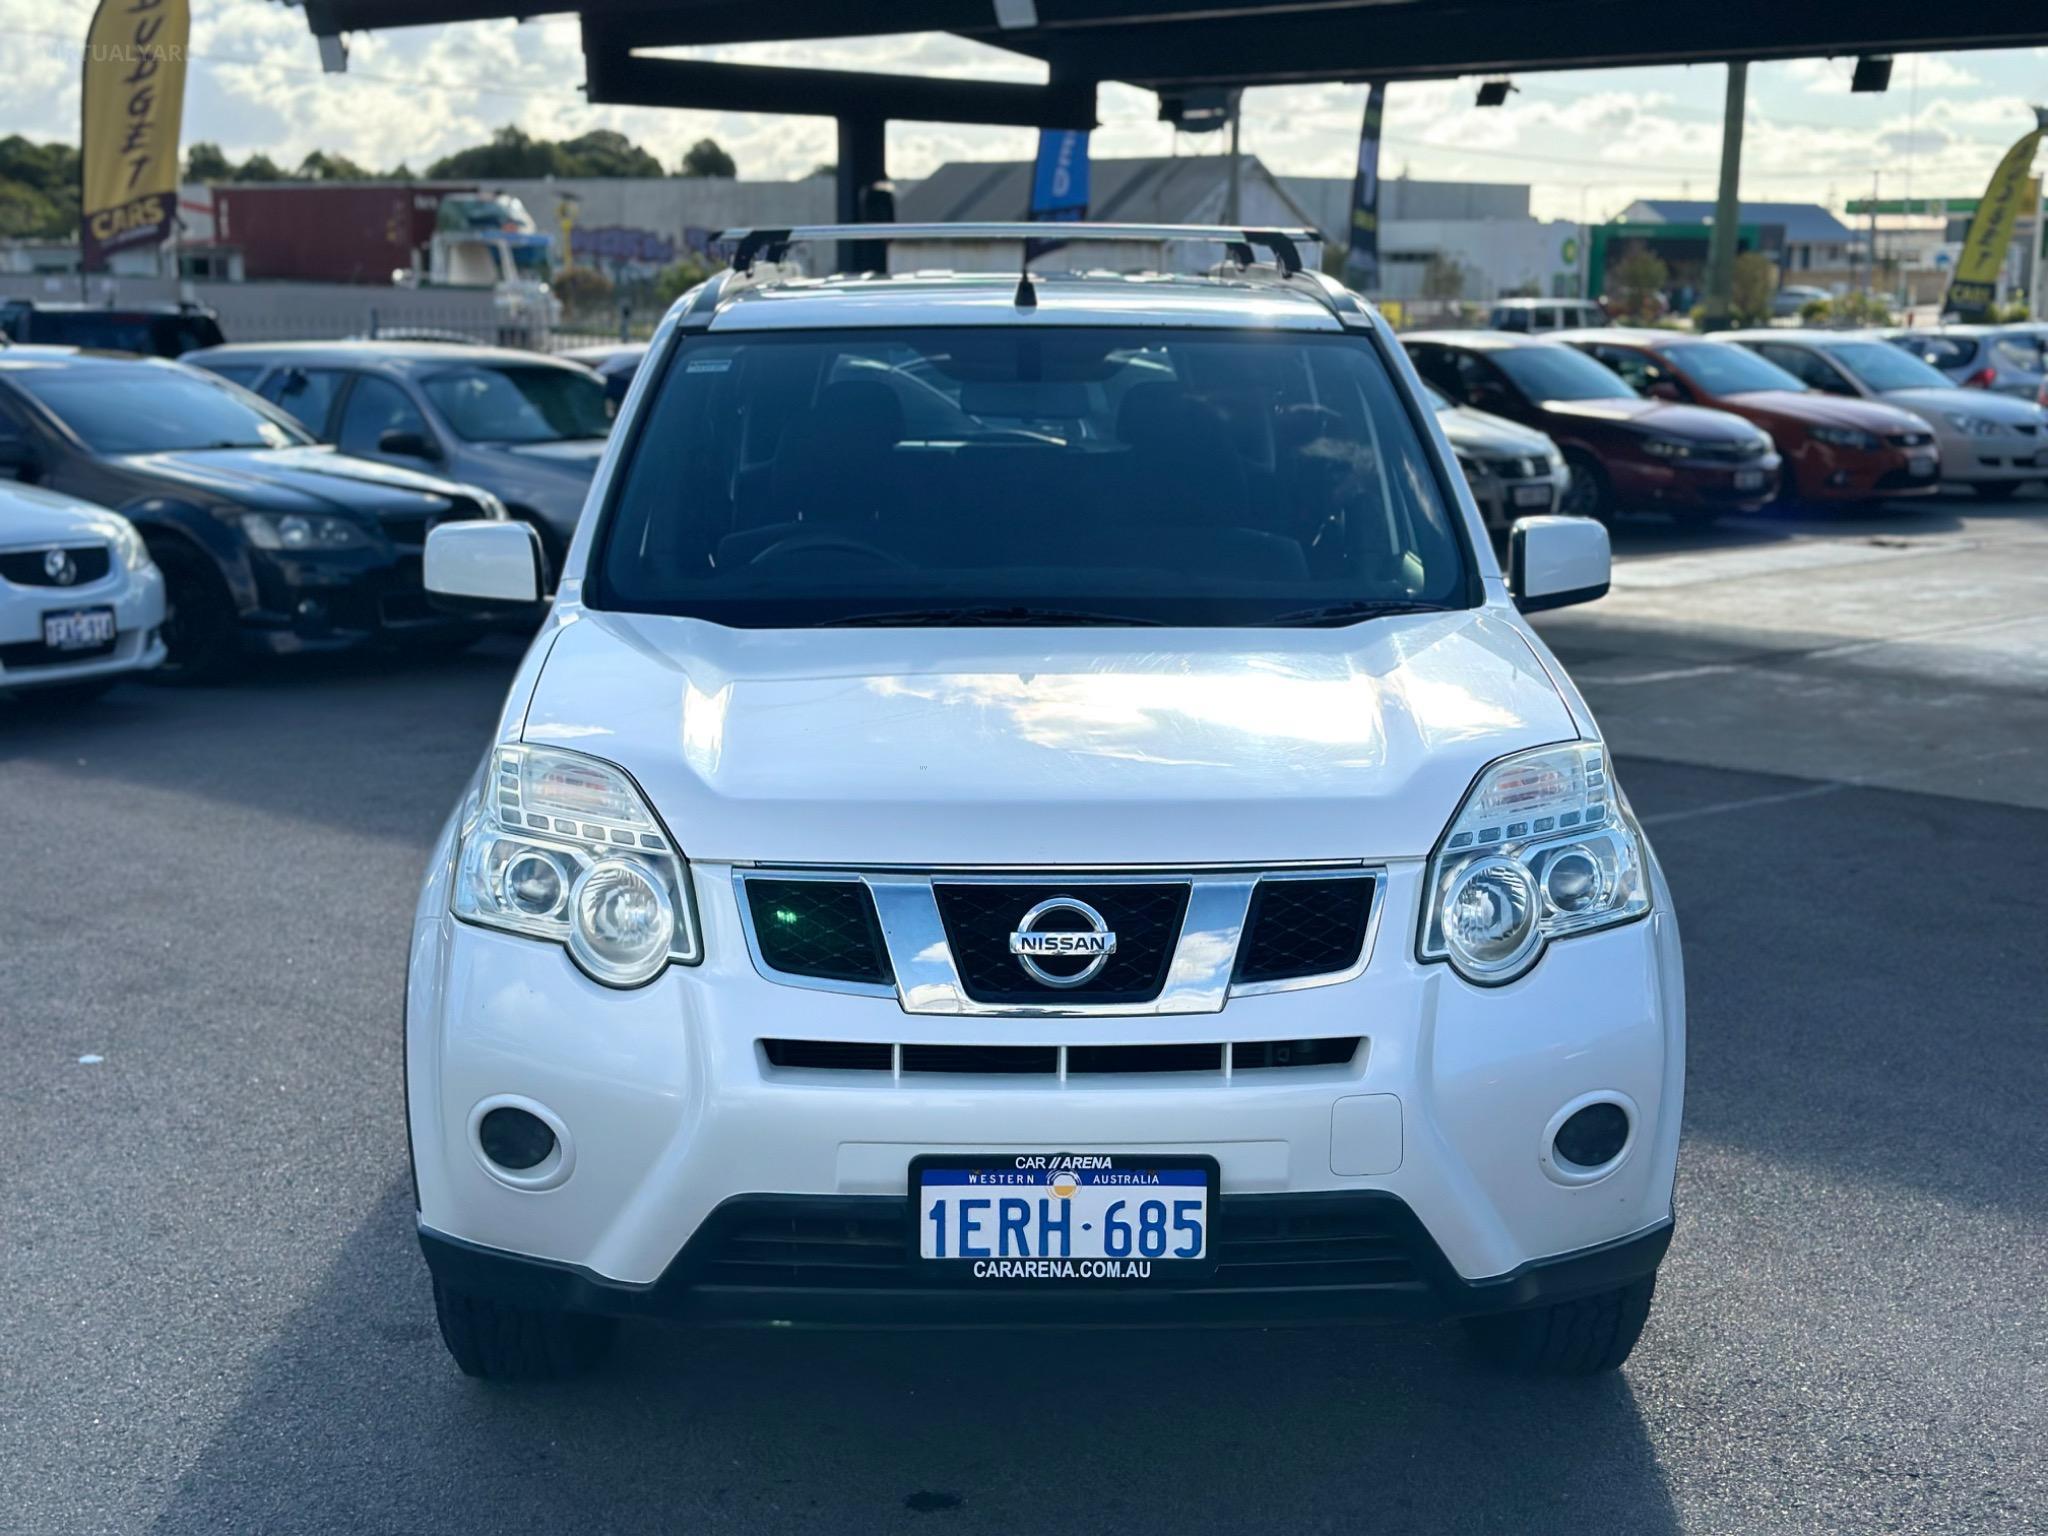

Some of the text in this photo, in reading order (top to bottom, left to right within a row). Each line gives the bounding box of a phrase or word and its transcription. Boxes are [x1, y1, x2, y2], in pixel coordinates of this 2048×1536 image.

[91, 197, 165, 239] CARS
[1021, 937, 1105, 951] NISSAN
[1015, 1156, 1046, 1169] CAR
[968, 1173, 1160, 1185] WESTERN AUSTRALIA
[973, 1260, 1151, 1278] CARARENA.COM.AU
